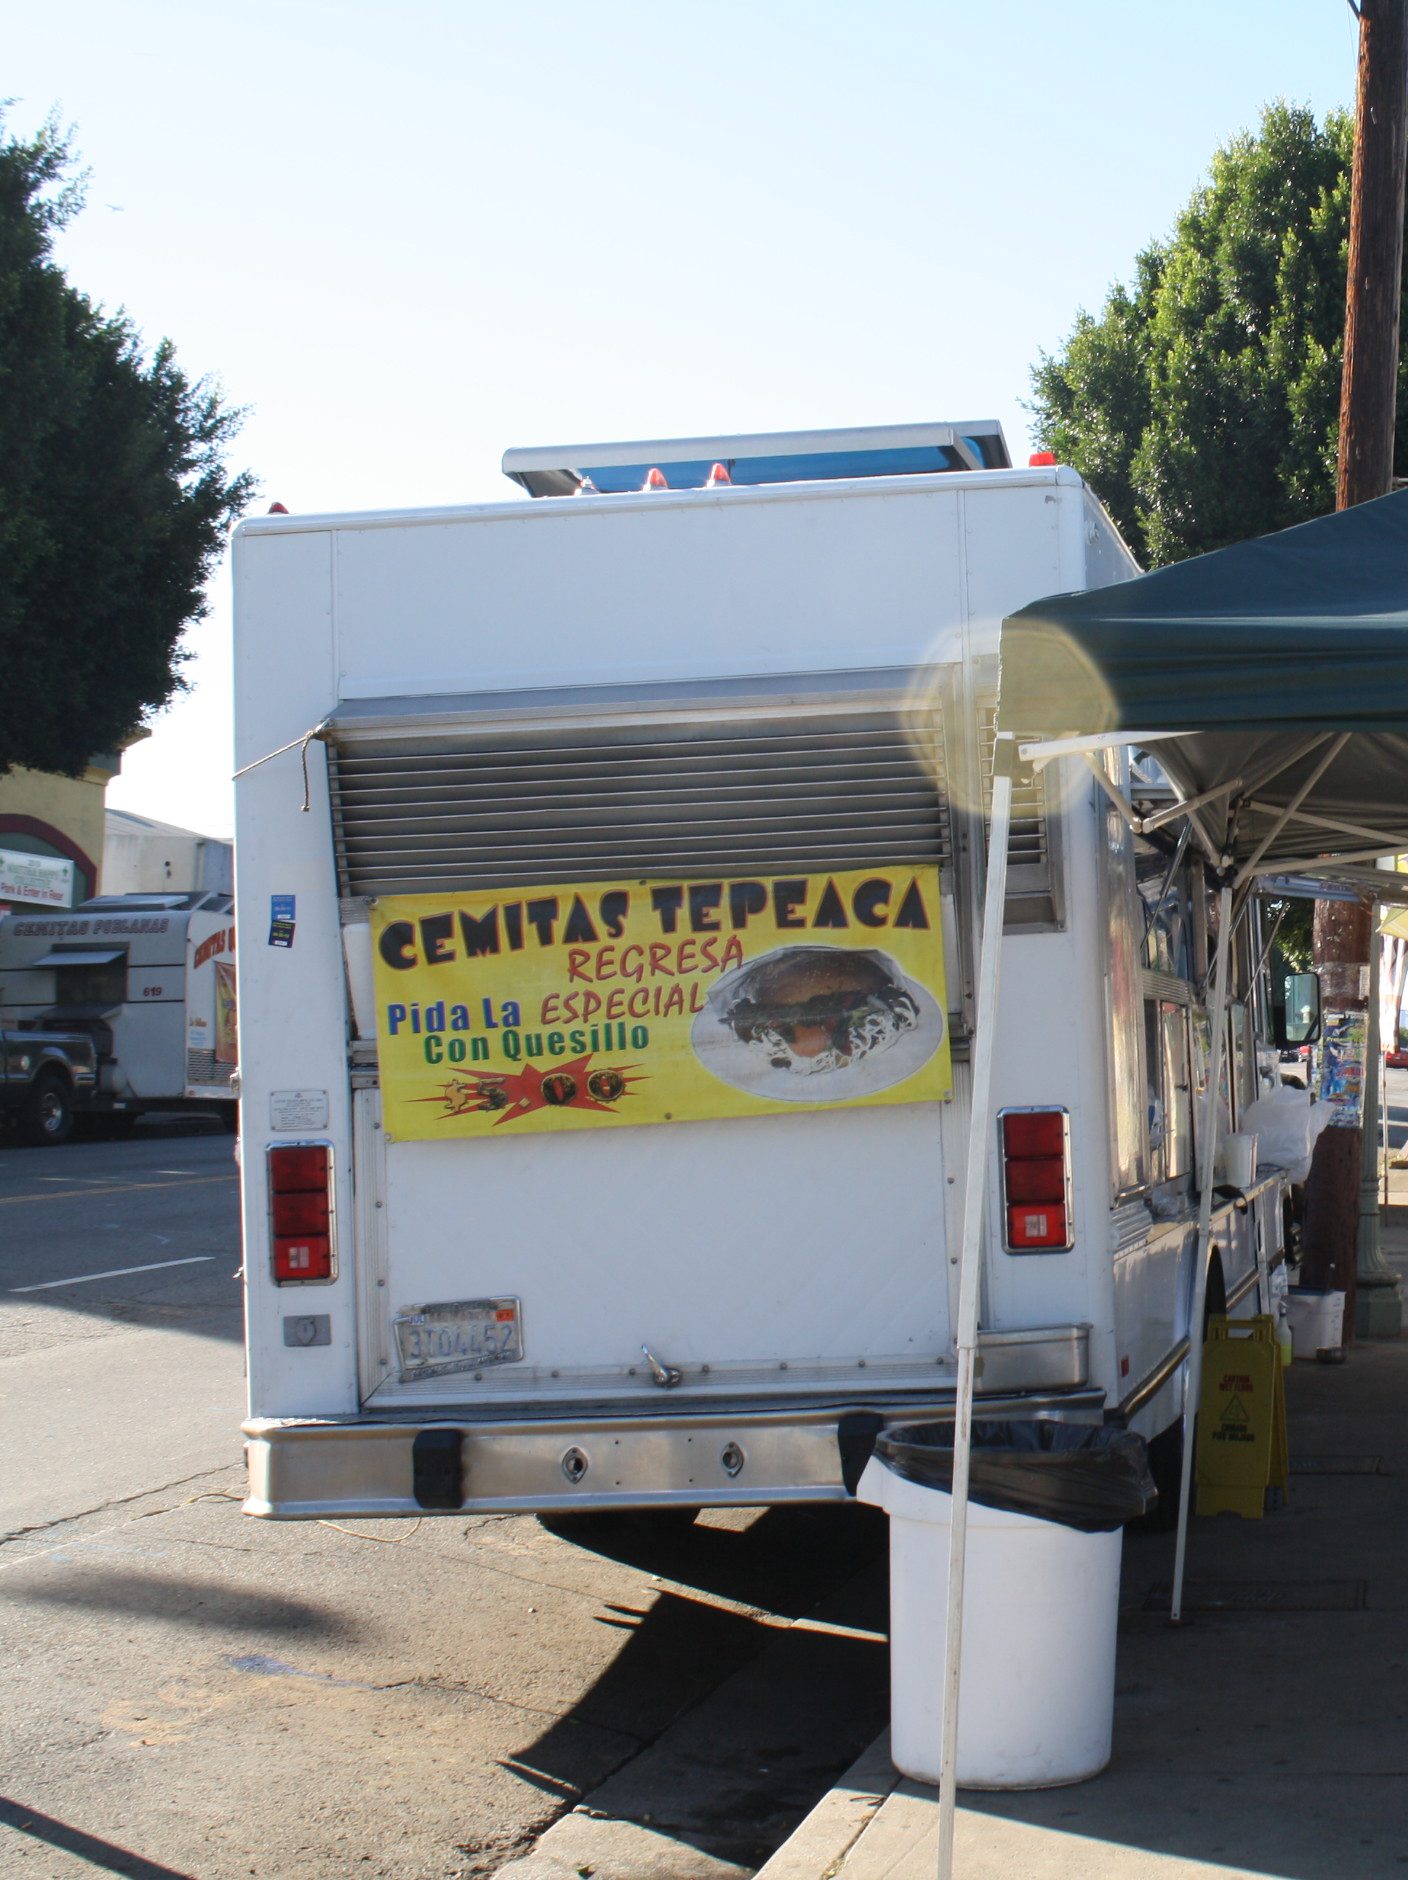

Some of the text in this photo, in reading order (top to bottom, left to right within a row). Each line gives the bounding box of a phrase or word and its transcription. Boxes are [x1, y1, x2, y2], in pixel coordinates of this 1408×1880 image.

[14, 920, 90, 936] CEMITAS
[378, 875, 931, 970] CEMITAS TEPEACA
[566, 934, 743, 983] REGRESA
[143, 986, 162, 997] 619
[386, 982, 704, 1036] Pida La ESPECIAL
[424, 1021, 650, 1064] Con Quesillo
[1223, 1374, 1250, 1383] CAUTION
[1219, 1382, 1254, 1392] WET FLOOR
[1212, 1432, 1227, 1441] PISO
